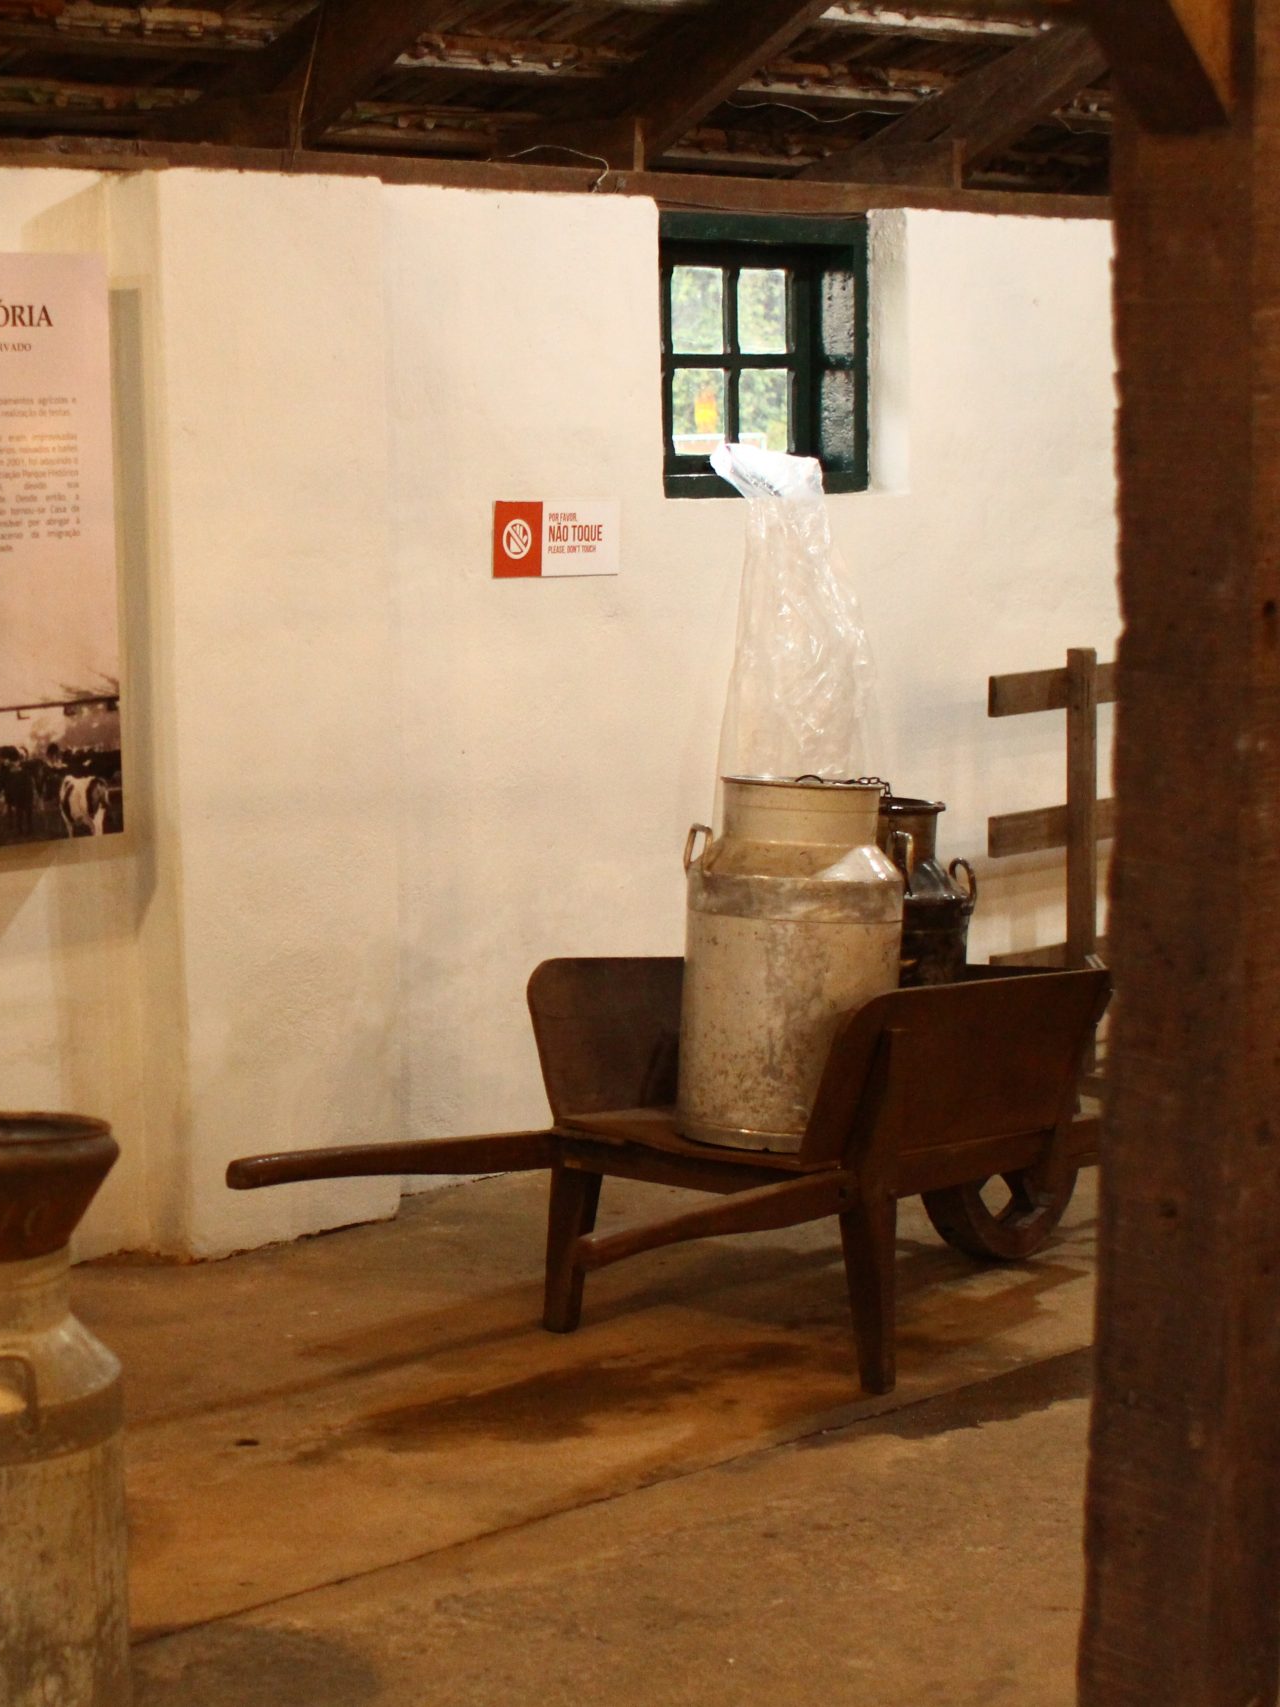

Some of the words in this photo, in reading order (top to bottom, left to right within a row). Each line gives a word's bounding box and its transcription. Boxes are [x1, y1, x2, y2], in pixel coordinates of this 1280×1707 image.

[548, 513, 559, 522] POR
[548, 522, 568, 542] NÃO
[572, 524, 602, 542] TOQUE
[582, 545, 596, 553] TOUCH
